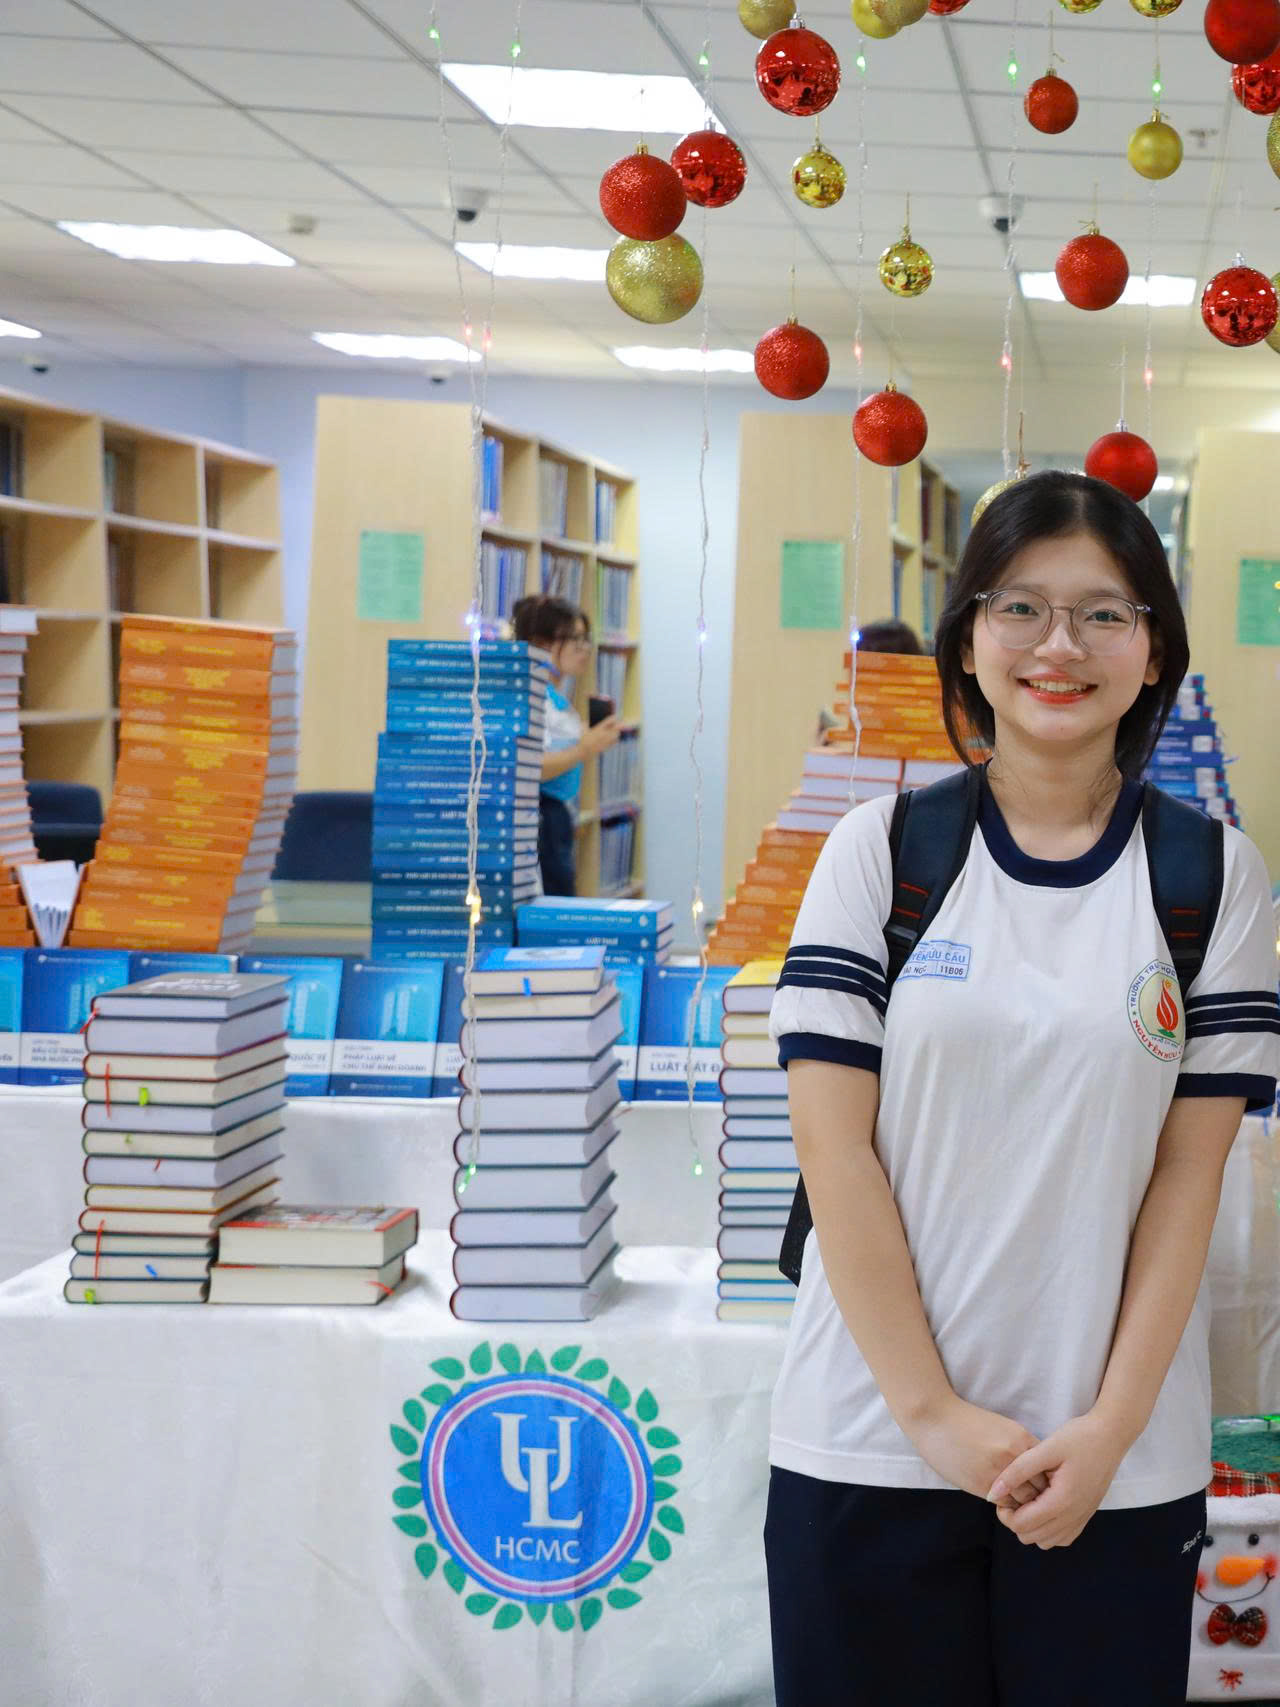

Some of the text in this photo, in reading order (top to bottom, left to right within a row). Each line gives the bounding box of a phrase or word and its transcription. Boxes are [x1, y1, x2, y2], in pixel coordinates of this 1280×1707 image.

[1145, 963, 1160, 975] TRU
[495, 1535, 581, 1565] HCMC
[1181, 1530, 1202, 1554] Spot
